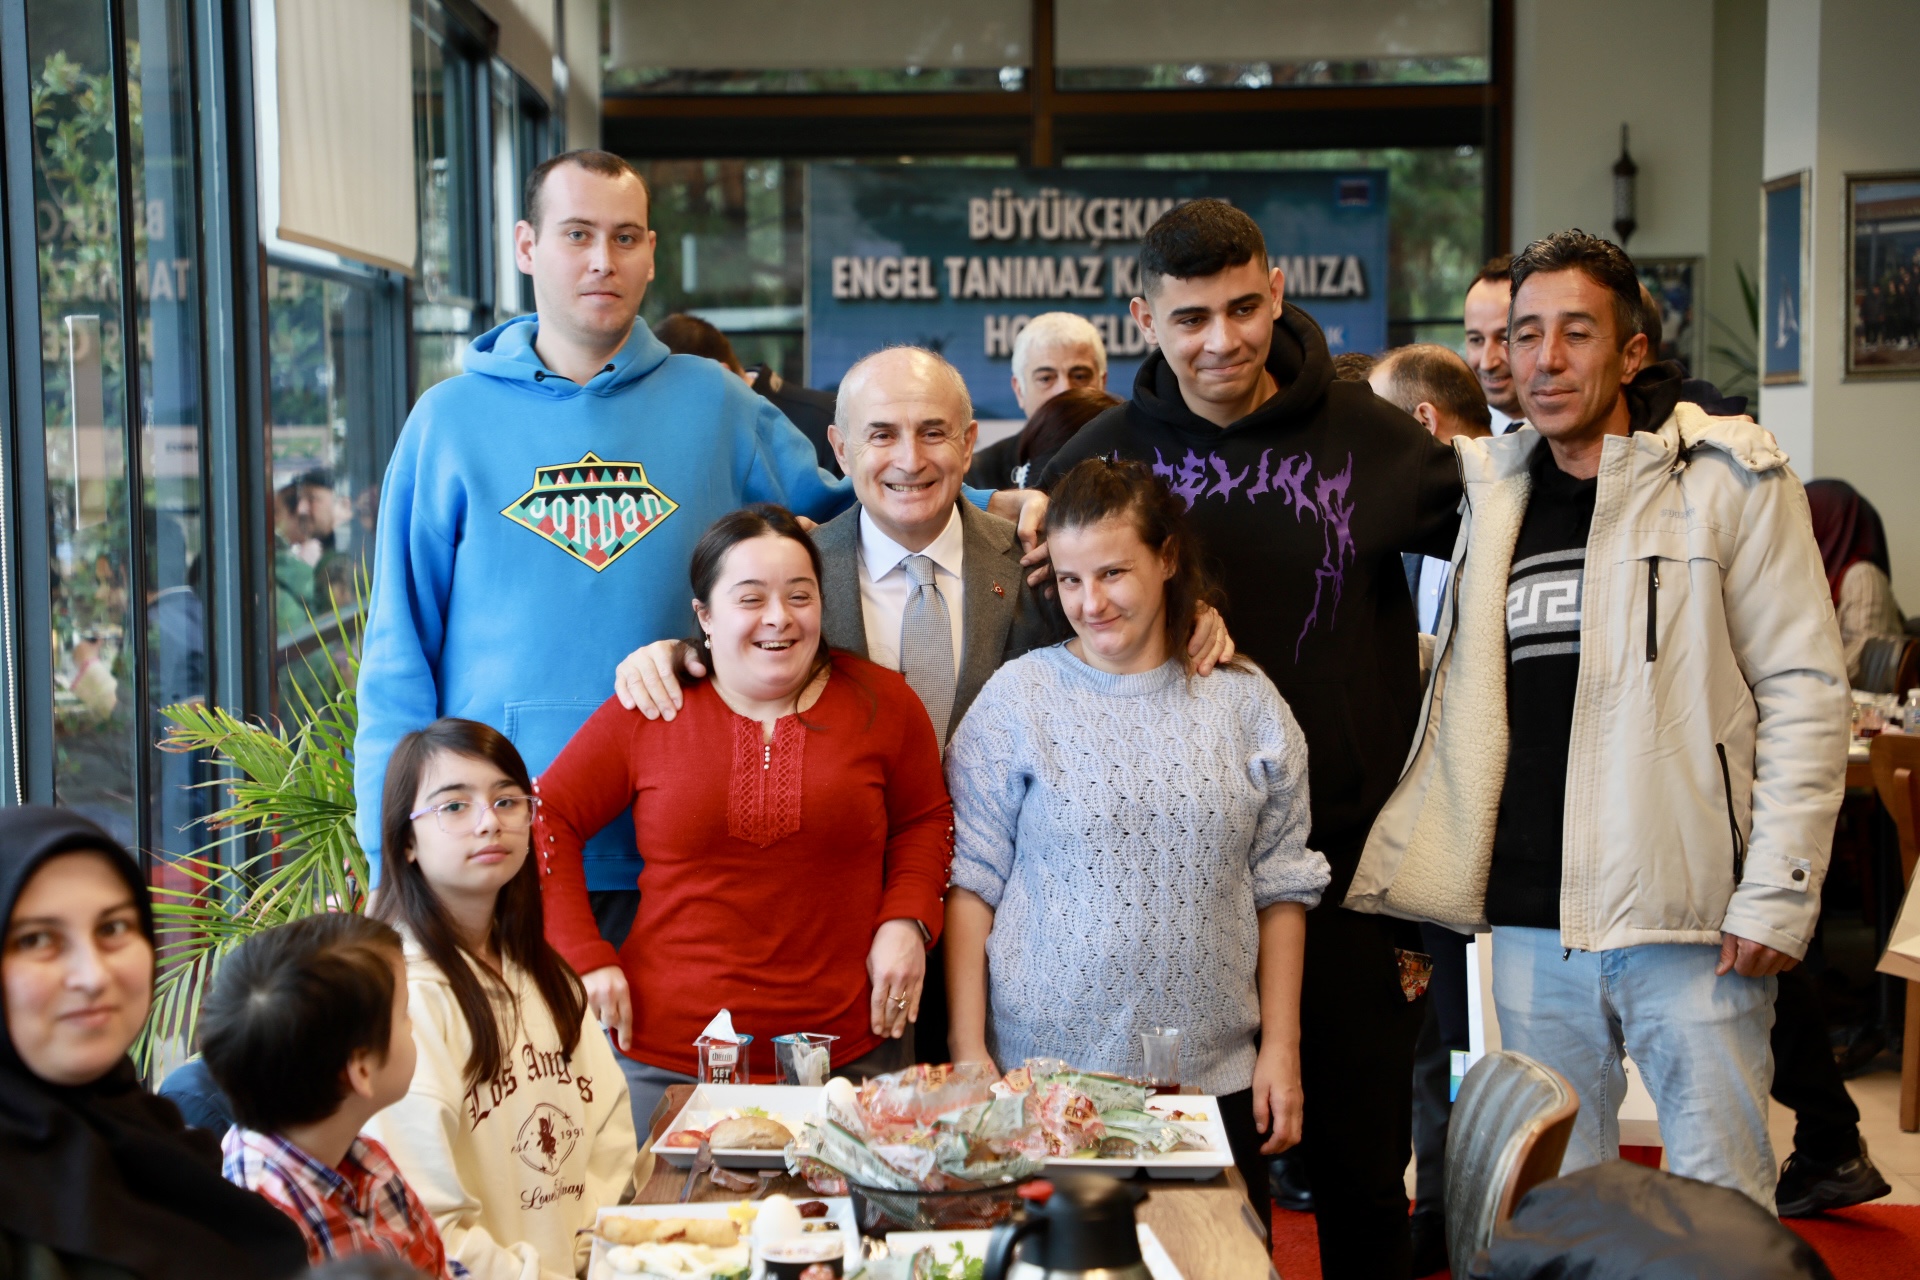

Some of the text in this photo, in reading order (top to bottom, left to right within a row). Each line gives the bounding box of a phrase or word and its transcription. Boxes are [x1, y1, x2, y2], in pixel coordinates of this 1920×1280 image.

[832, 256, 937, 299] ENGEL
[944, 256, 1102, 298] TANIMAZ
[555, 471, 626, 485] AIR
[712, 1067, 731, 1079] KET
[463, 1060, 518, 1132] Los
[560, 1127, 585, 1141] 1991
